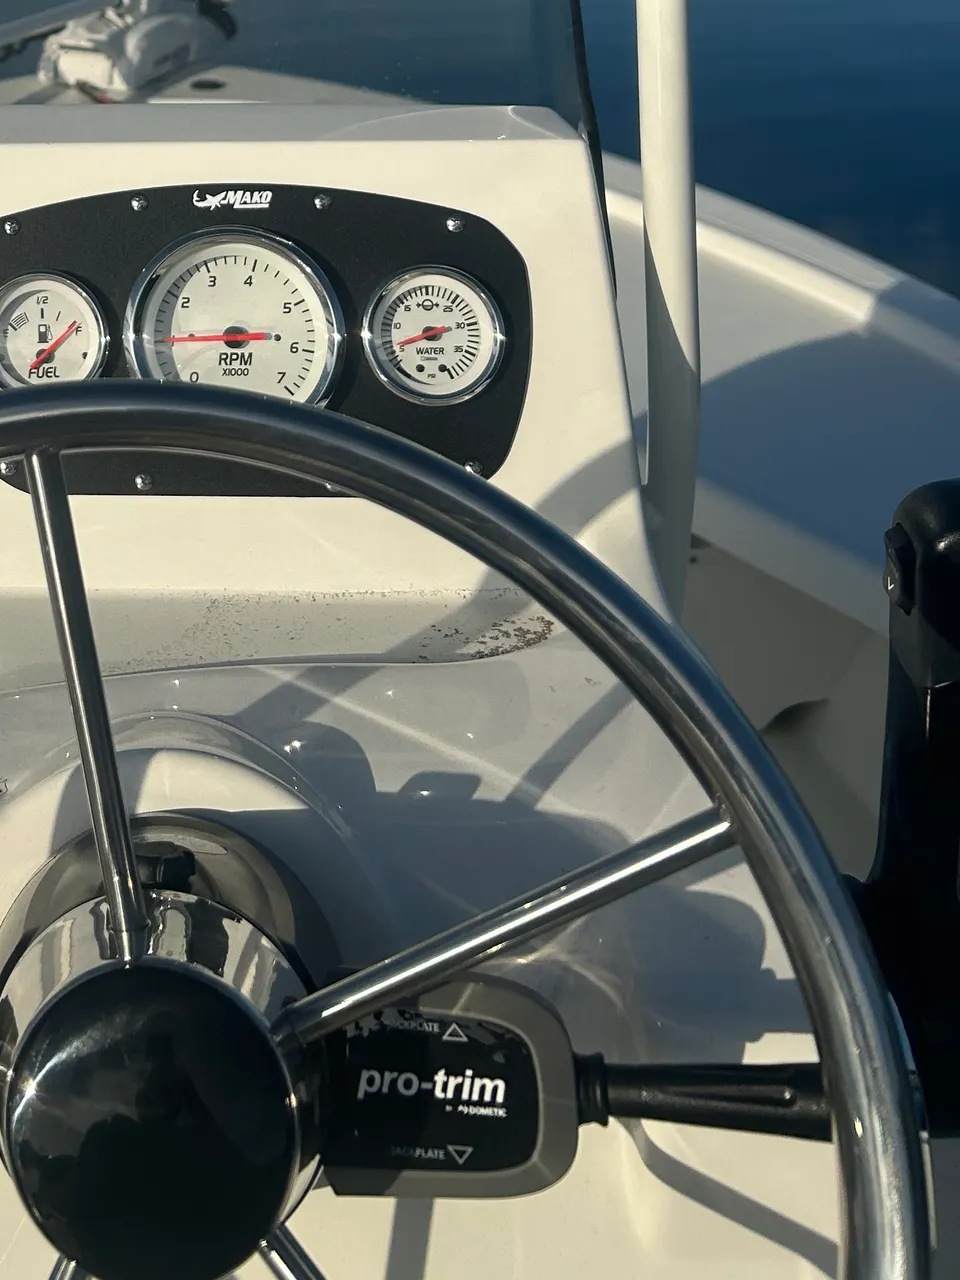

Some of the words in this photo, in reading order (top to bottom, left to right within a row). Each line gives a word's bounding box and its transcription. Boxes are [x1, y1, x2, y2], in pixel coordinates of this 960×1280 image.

[220, 190, 272, 209] MAKO
[208, 275, 217, 287] 3
[243, 275, 253, 287] 4
[36, 296, 49, 305] 1/2
[181, 297, 190, 308] 2
[282, 302, 292, 314] 5
[75, 325, 83, 336] F
[290, 342, 299, 354] 6
[416, 347, 445, 355] WATER
[218, 352, 253, 366] RPM
[28, 366, 60, 379] FUEL
[189, 372, 199, 383] 0
[222, 368, 249, 377] X1000
[277, 372, 286, 384] 7
[357, 1068, 506, 1104] pro-trim
